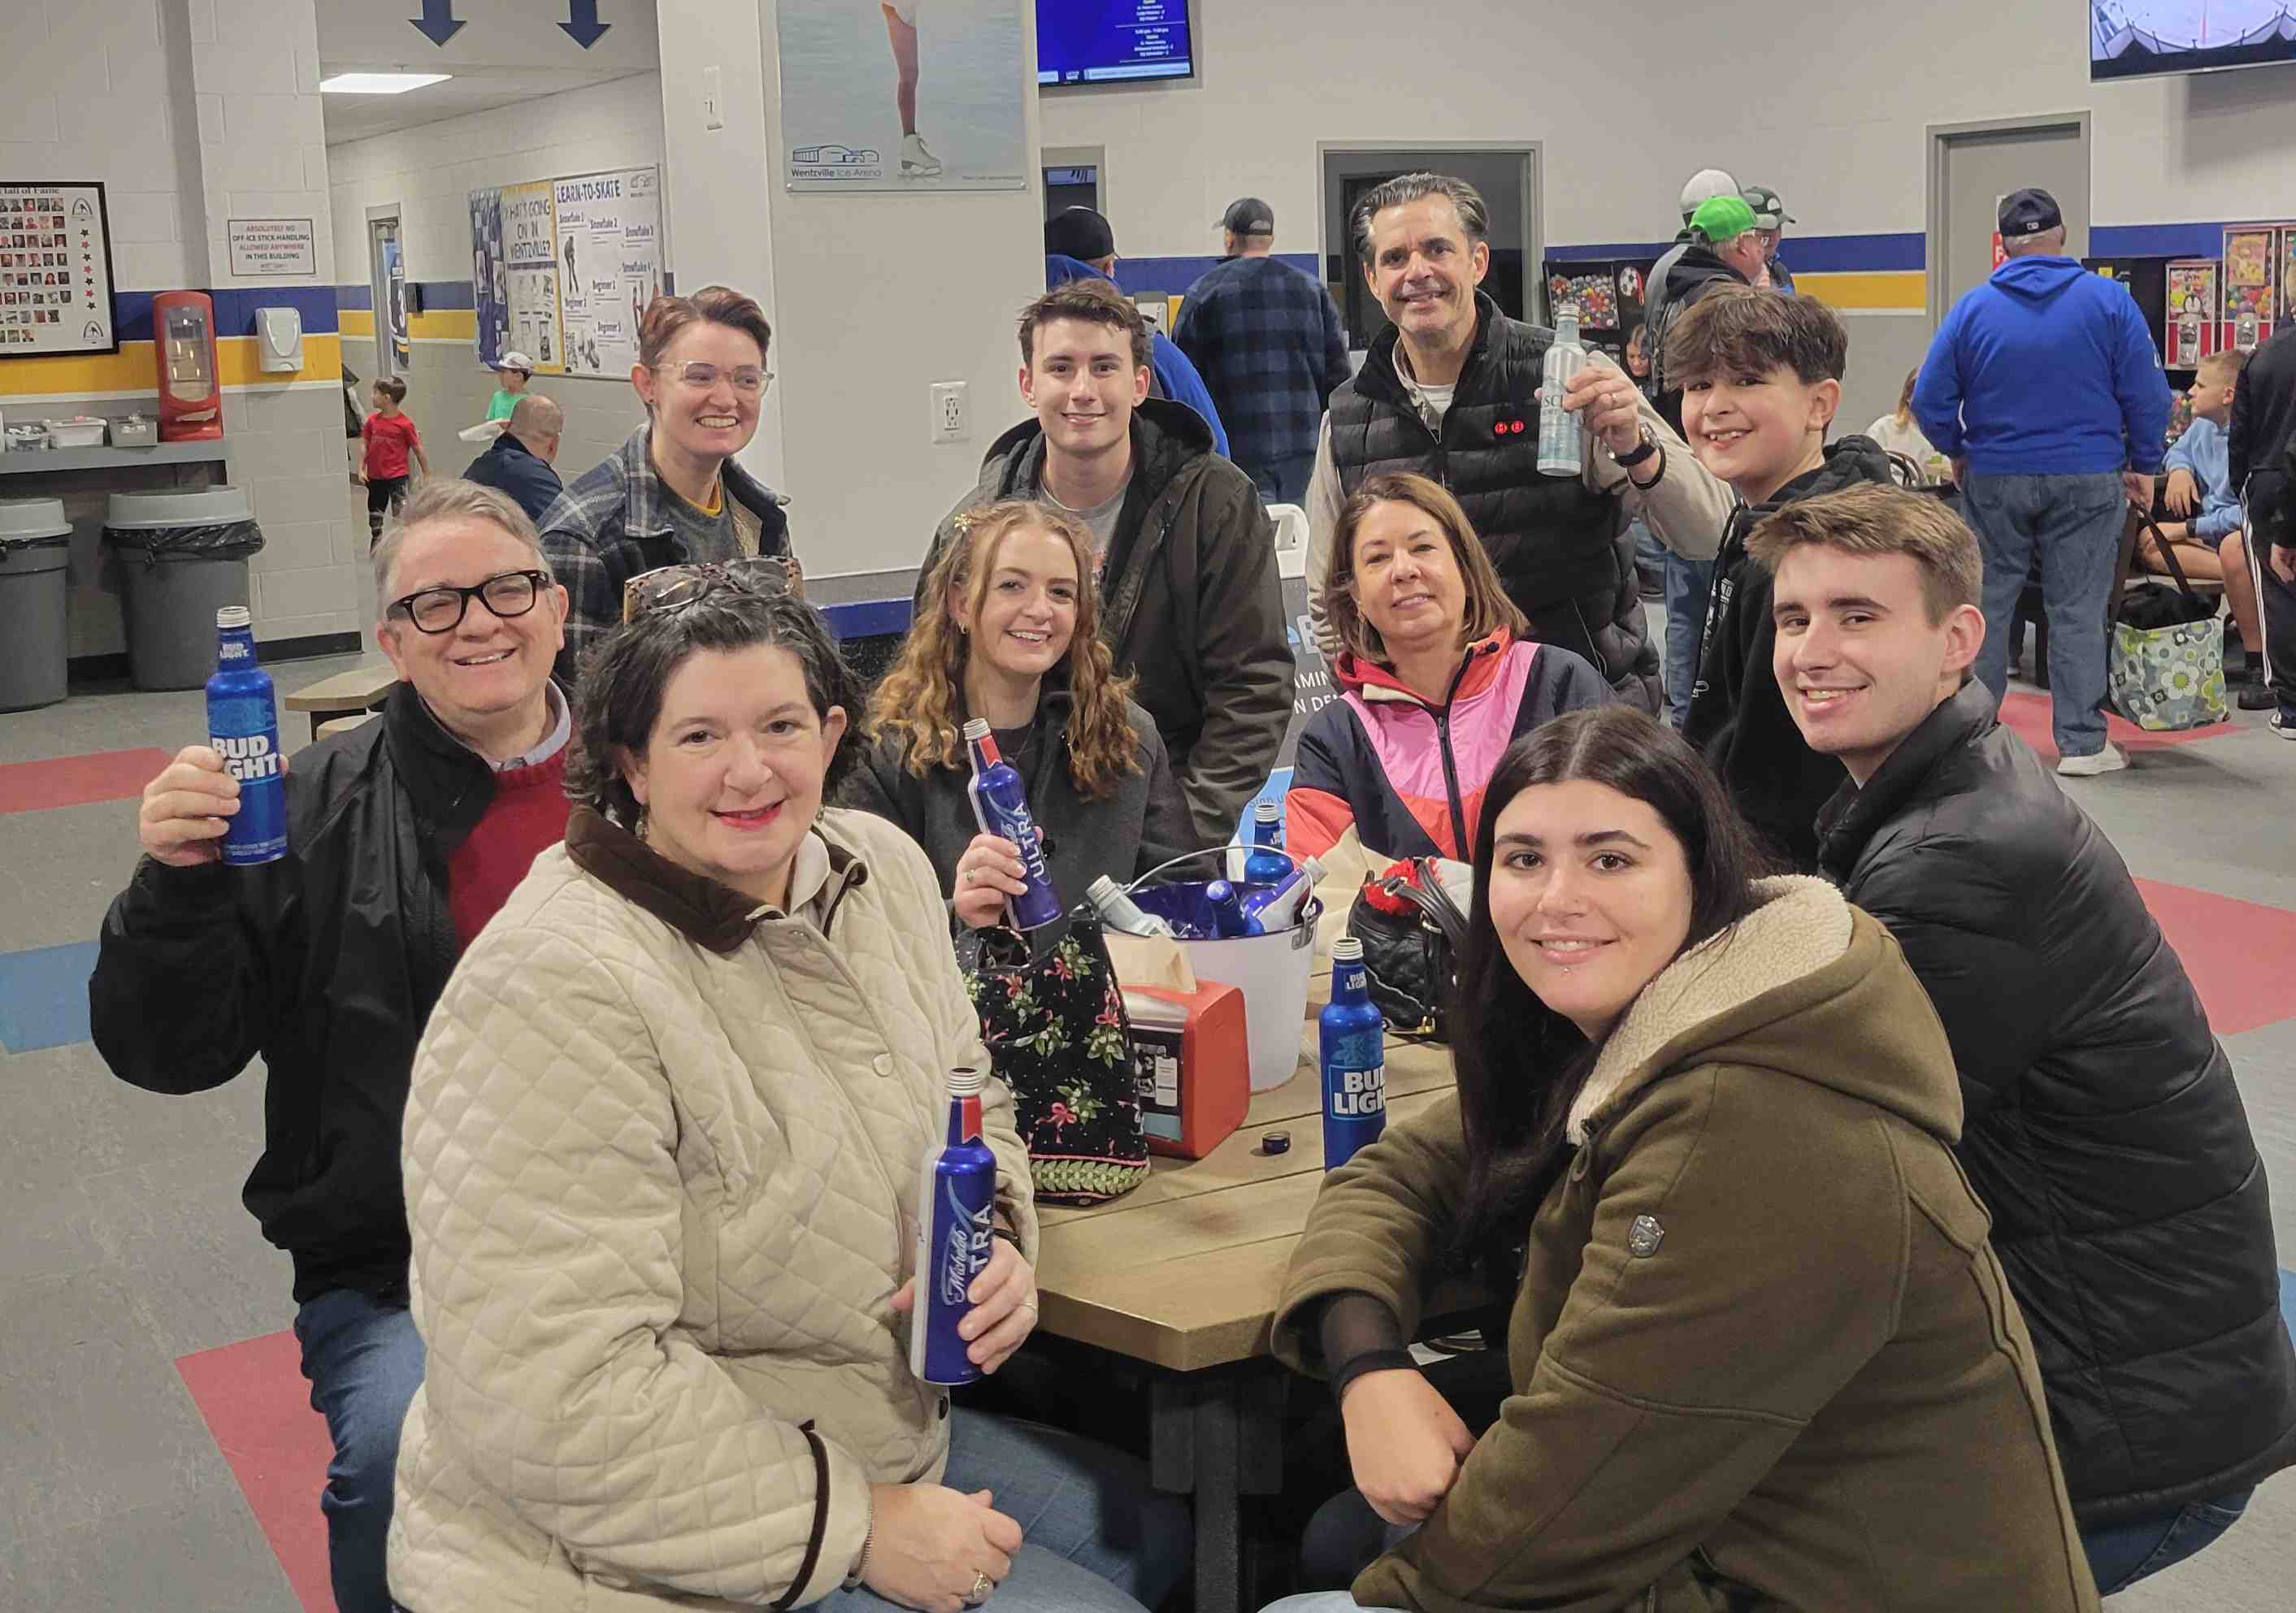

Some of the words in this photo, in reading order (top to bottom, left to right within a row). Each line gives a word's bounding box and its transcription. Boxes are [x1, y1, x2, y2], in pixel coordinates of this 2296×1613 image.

[792, 168, 835, 177] Wentzville
[837, 168, 852, 176] Ice
[854, 168, 882, 176] Arena
[21, 187, 32, 195] of
[557, 179, 621, 203] LEARN-TO-SKATE
[211, 735, 269, 759] BUD
[224, 752, 278, 781] GHT
[1013, 801, 1045, 879] ULTRA
[1334, 1086, 1385, 1114] LIGH
[970, 1203, 992, 1274] TRA
[947, 1229, 968, 1304] Michelob
